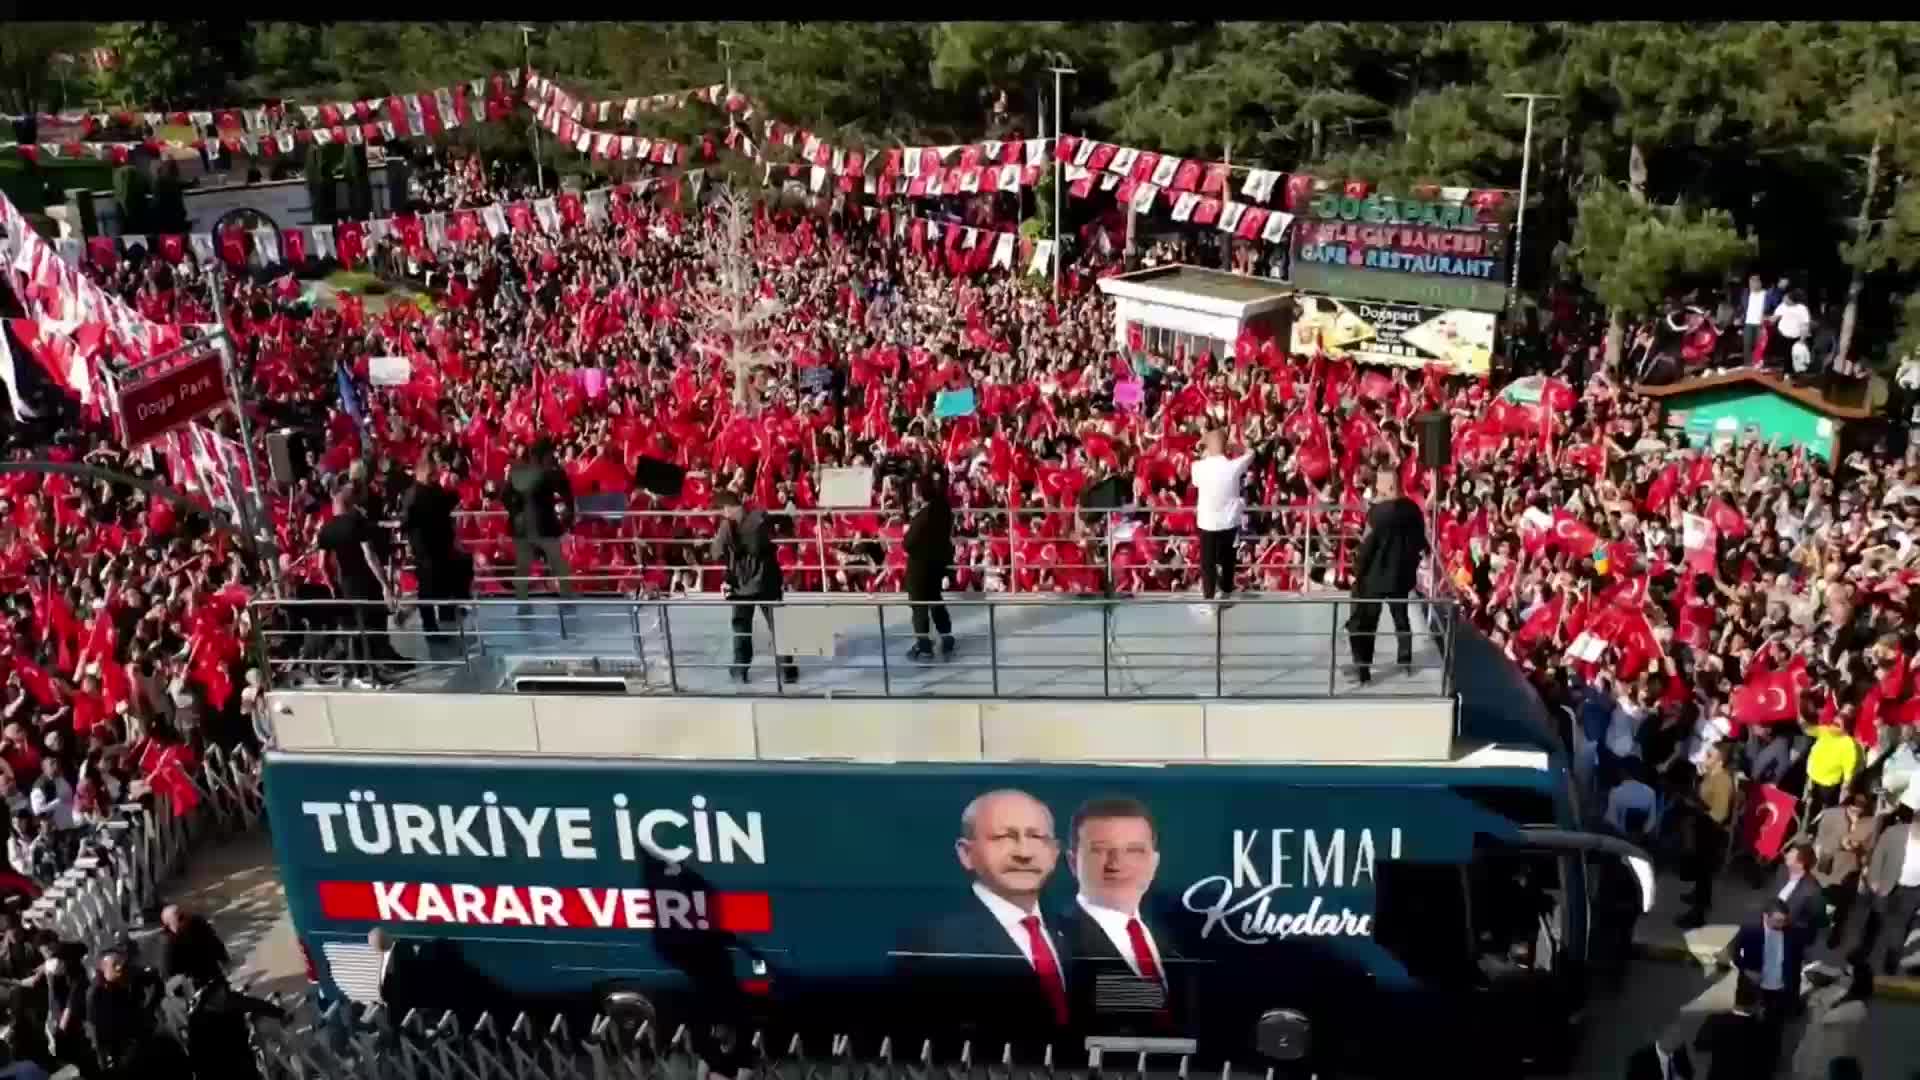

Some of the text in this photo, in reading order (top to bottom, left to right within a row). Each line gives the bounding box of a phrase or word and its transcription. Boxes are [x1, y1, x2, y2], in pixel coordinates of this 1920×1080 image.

[1367, 249, 1494, 277] RESTAURANT
[302, 790, 766, 876] TÜRKİYE İÇİN
[372, 881, 710, 931] KARAR VER!
